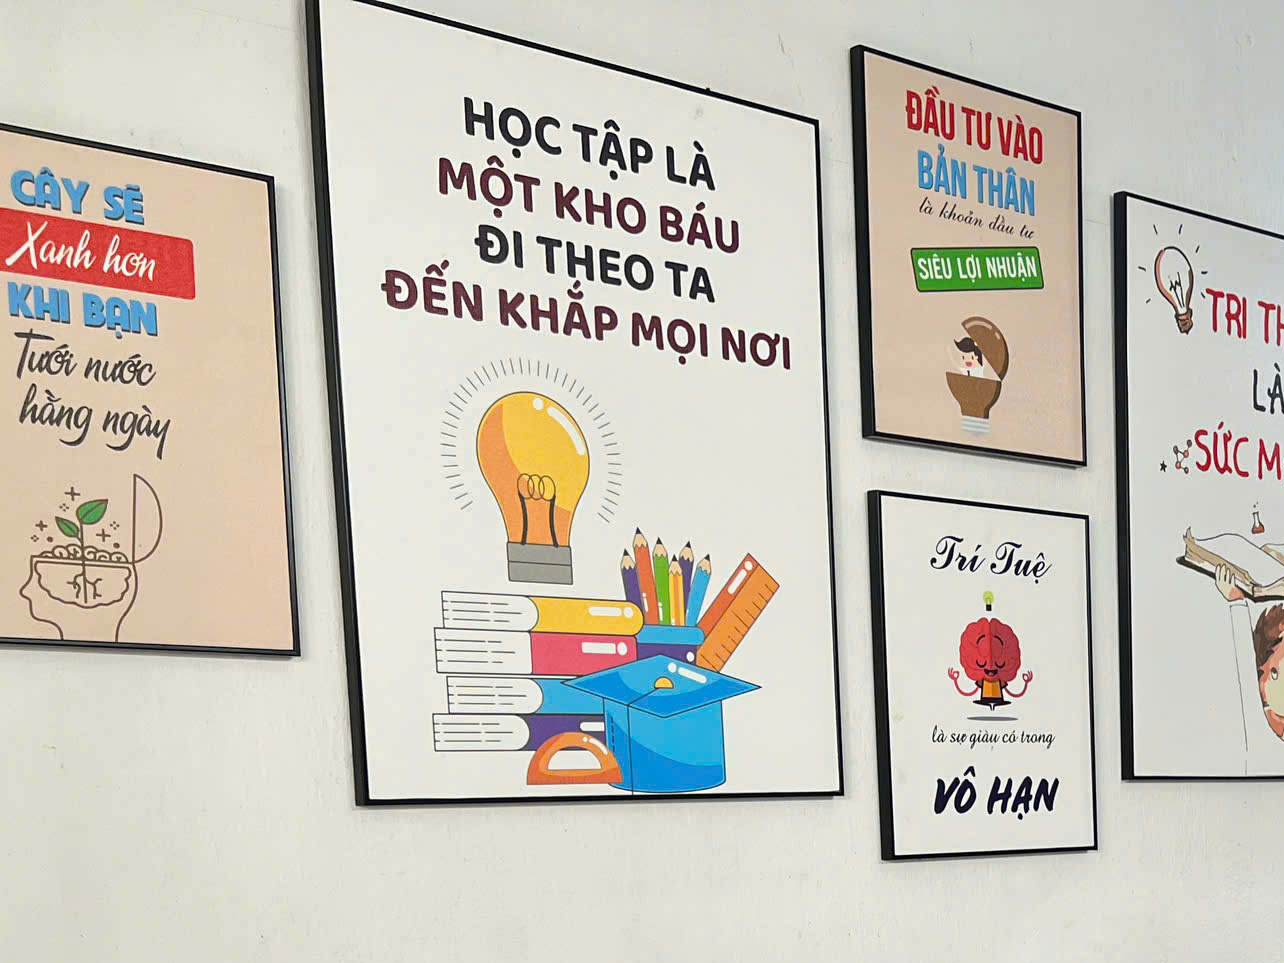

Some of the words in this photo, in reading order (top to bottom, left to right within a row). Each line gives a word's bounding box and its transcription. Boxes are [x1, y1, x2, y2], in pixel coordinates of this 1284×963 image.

[463, 96, 562, 158] HỌC
[572, 119, 654, 181] TẬP
[665, 140, 716, 191] LÀ
[906, 85, 955, 141] ĐẦU
[961, 106, 992, 151] TƯ
[997, 114, 1044, 165] VÀO
[10, 167, 90, 215] CÂY
[103, 184, 146, 226] SẼ
[438, 155, 541, 218] MỘT
[555, 182, 647, 234] KHO
[659, 202, 740, 254] BÁU
[917, 144, 967, 200] BẢN
[973, 167, 1036, 217] THÂN
[919, 196, 934, 215] là
[939, 201, 984, 228] khoản
[988, 214, 1015, 235] đầu
[1020, 224, 1035, 240] tư
[5, 220, 96, 270] Xanh
[103, 234, 156, 281] hơn
[474, 224, 523, 268] ĐI
[536, 236, 654, 291] THEO
[665, 261, 715, 303] TA
[917, 253, 952, 280] SIÊU
[957, 254, 982, 283] LỢI
[986, 252, 1038, 282] NHUẬN
[7, 282, 71, 324] KHI
[82, 292, 158, 339] BẠN
[381, 259, 484, 322] ĐẾN
[499, 280, 618, 341] KHẮP
[632, 312, 708, 365] MỌI
[721, 327, 791, 370] NƠI
[1205, 288, 1247, 339] TRI
[14, 328, 78, 380] Tưới
[84, 354, 157, 387] nước
[18, 383, 94, 447] hằng
[101, 404, 172, 460] ngày
[1194, 421, 1250, 478] SỨC
[930, 535, 987, 573] Trí
[990, 541, 1053, 584] Tuệ
[932, 725, 946, 744] là
[950, 731, 967, 747] sự
[969, 727, 999, 750] giàu
[1002, 727, 1017, 744] có
[1021, 731, 1055, 750] trong
[934, 765, 977, 815] VÔ
[987, 775, 1060, 820] HẠN
